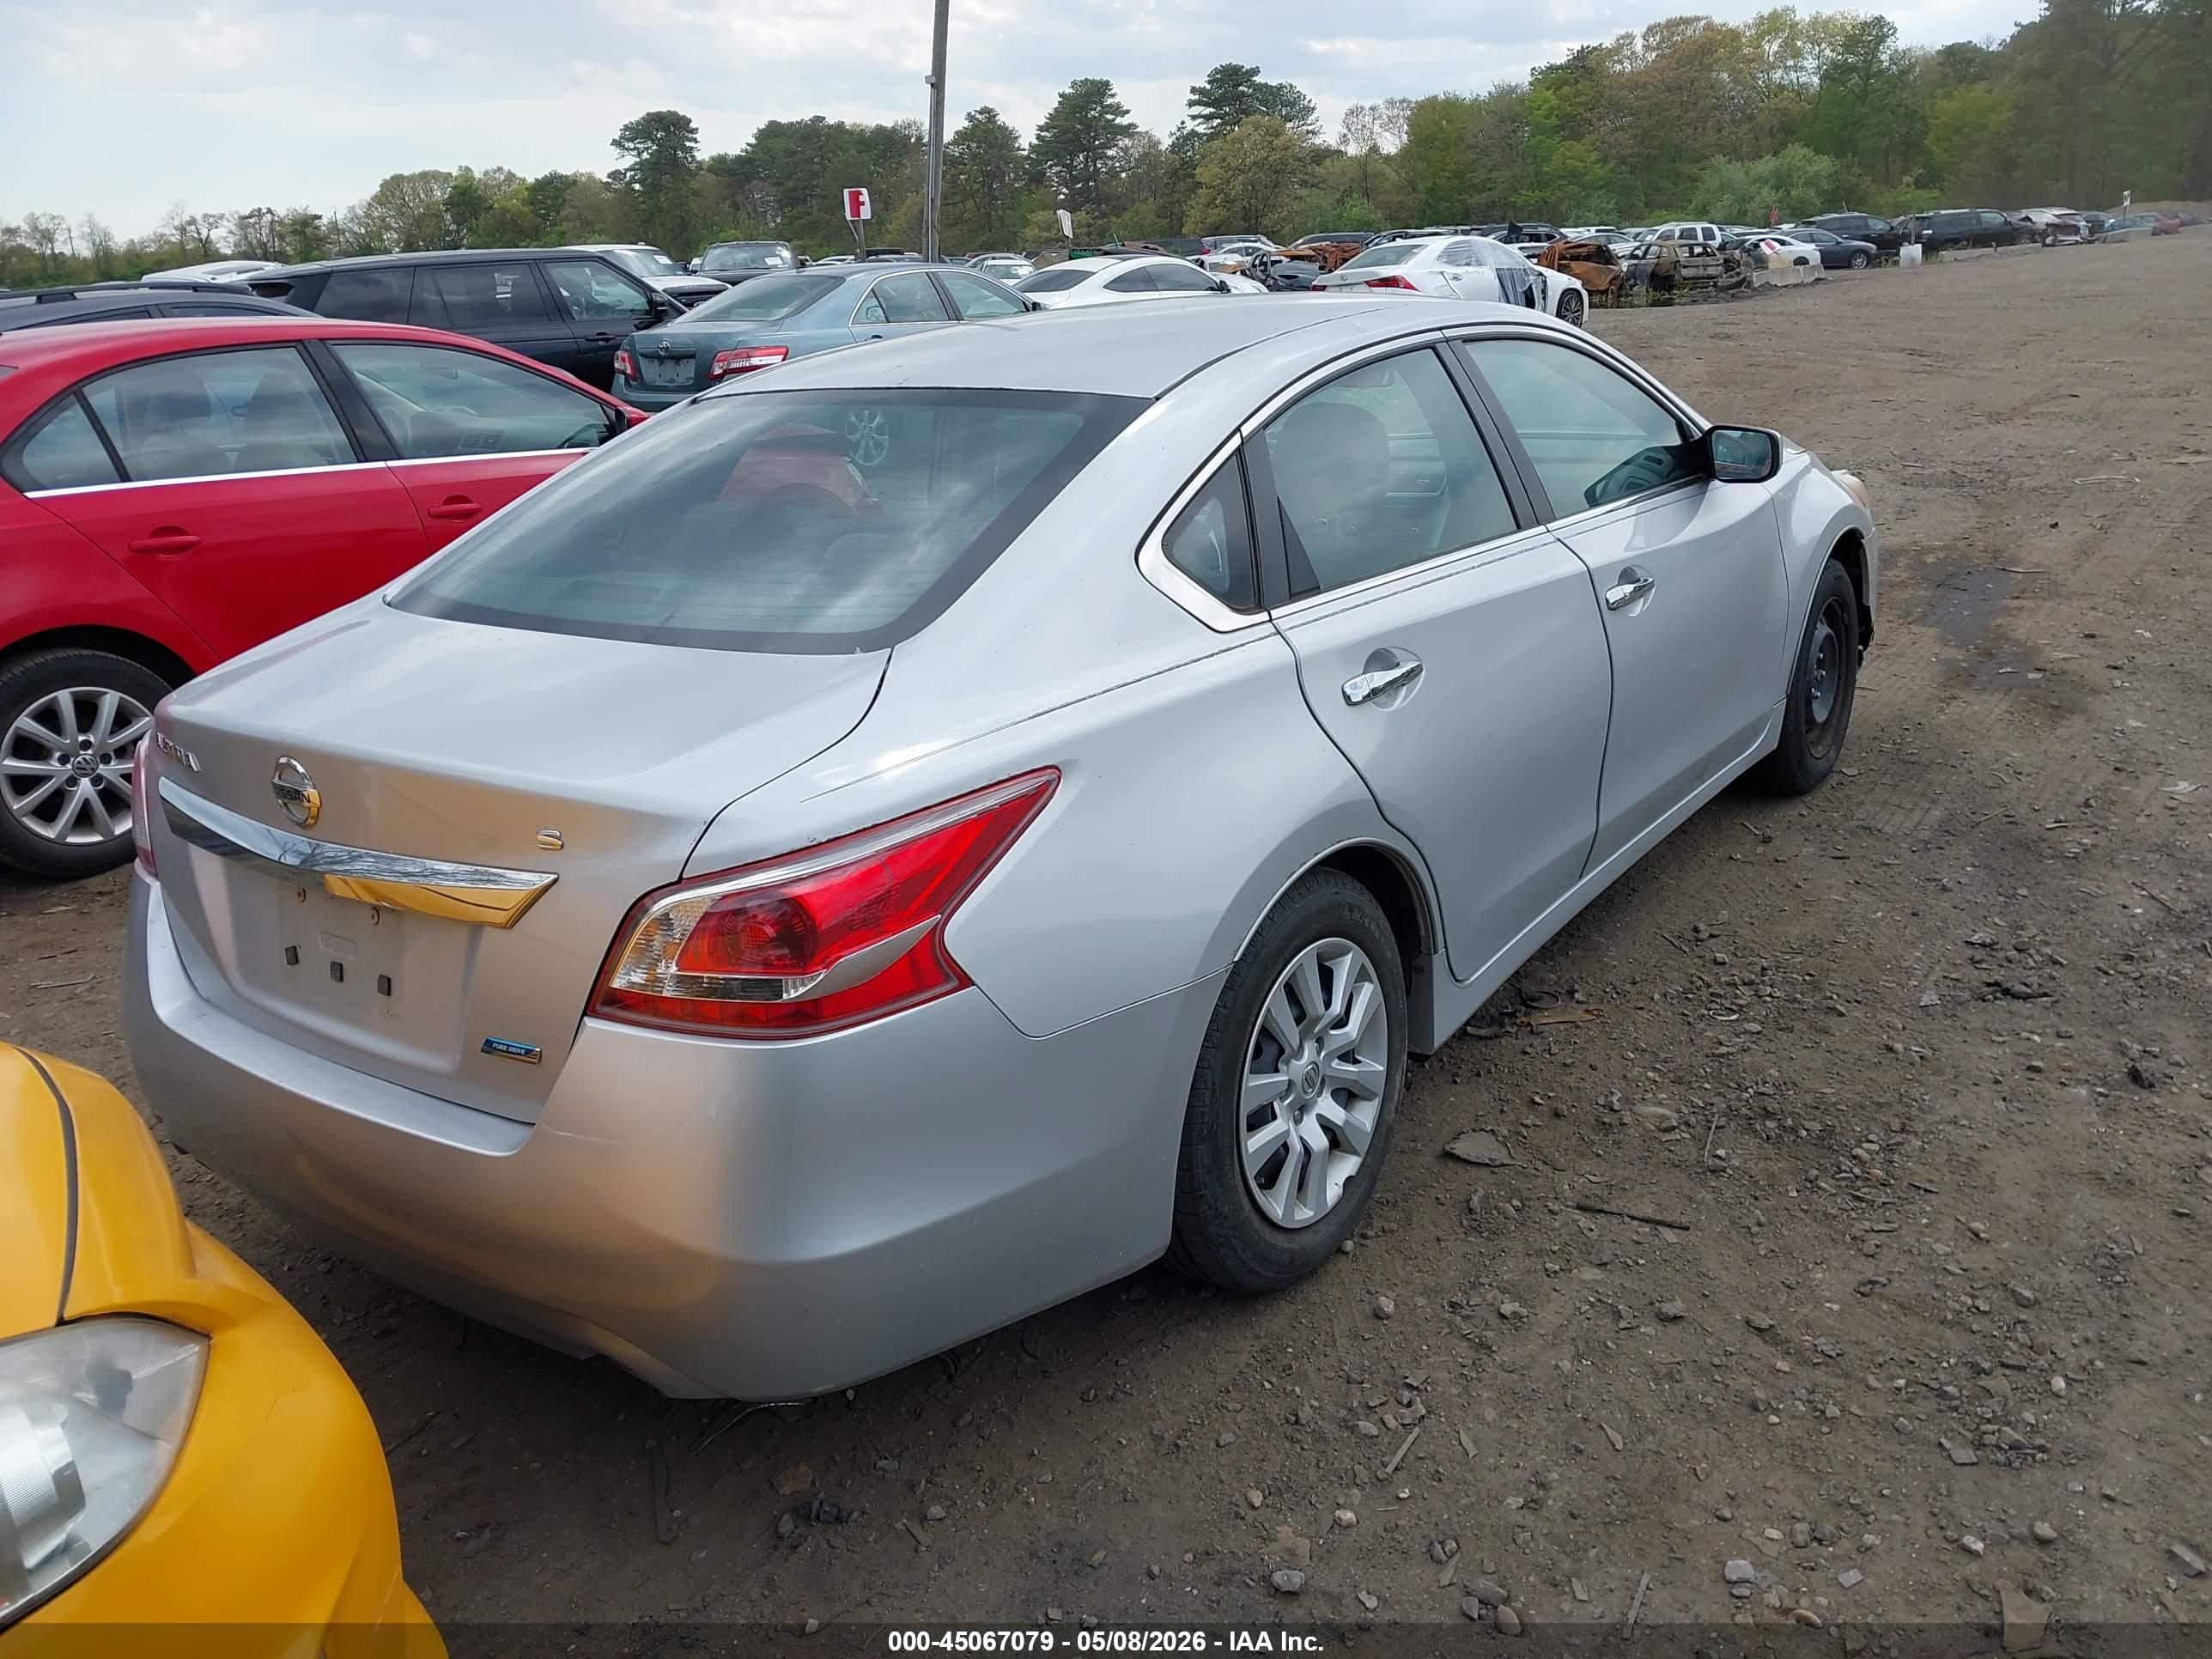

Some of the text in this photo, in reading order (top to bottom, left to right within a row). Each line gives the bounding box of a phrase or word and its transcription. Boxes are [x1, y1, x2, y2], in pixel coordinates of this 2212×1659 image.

[848, 190, 865, 218] F
[536, 829, 563, 850] S
[507, 1046, 526, 1055] DRIVE
